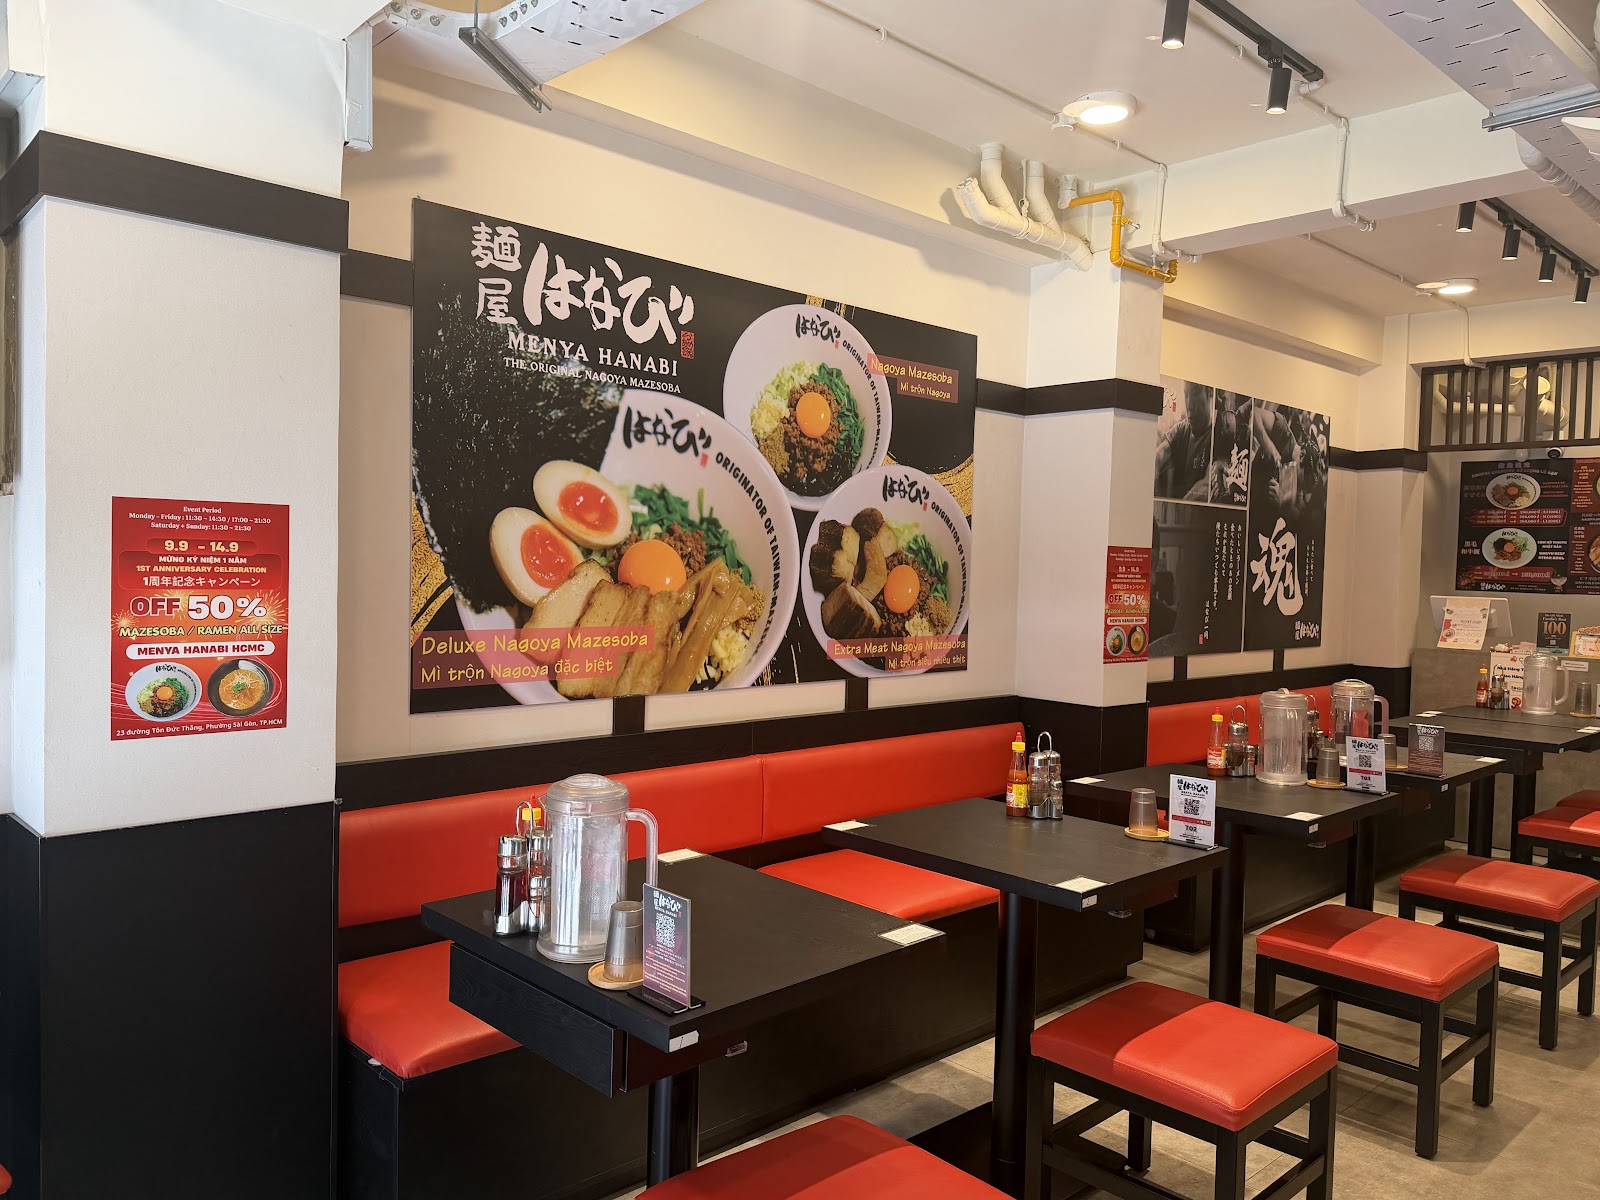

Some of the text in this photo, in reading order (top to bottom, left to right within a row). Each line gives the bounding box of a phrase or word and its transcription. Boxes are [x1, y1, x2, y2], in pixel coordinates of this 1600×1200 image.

[523, 242, 694, 344] はなび
[796, 314, 841, 343] はなび
[507, 332, 678, 376] MENYA HANABI
[842, 340, 871, 380] ORIGINATOR
[870, 380, 876, 391] OF
[504, 356, 680, 394] THE ORIGINAL NAGOYA MAZESOBA
[870, 358, 952, 384] Nagoya Mazesoba
[900, 382, 908, 392] Mì
[926, 387, 950, 399] Nagoya
[623, 406, 712, 456] はなび
[715, 452, 767, 519] ORIGINATOR
[764, 518, 775, 535] OF
[882, 474, 930, 505] はなび
[129, 512, 155, 520] Monday
[151, 522, 180, 530] Saturday
[931, 502, 960, 544] ORIGINATOR
[957, 544, 965, 556] OF
[164, 540, 188, 551] 9.9
[210, 541, 239, 552] 14.9
[1250, 517, 1304, 616] 魂
[143, 576, 260, 587] 1周年記念キャンペーン
[130, 594, 267, 620] OFF 50%
[1109, 594, 1146, 606] OFF 50%
[119, 626, 185, 637] MAZESOBA
[198, 625, 237, 636] RAMEN
[239, 625, 258, 634] ALL
[262, 624, 282, 634] SIZE
[1543, 621, 1566, 635] 100
[138, 644, 264, 656] MENYA HANABI HCMC
[422, 631, 648, 655] Deluxe Nagoya Mazesoba
[834, 640, 966, 656] Extra Meat Nagoya Mazesoba
[421, 657, 613, 683] Mì trộn Nagoya đặc biệt
[1183, 781, 1208, 793] はなび
